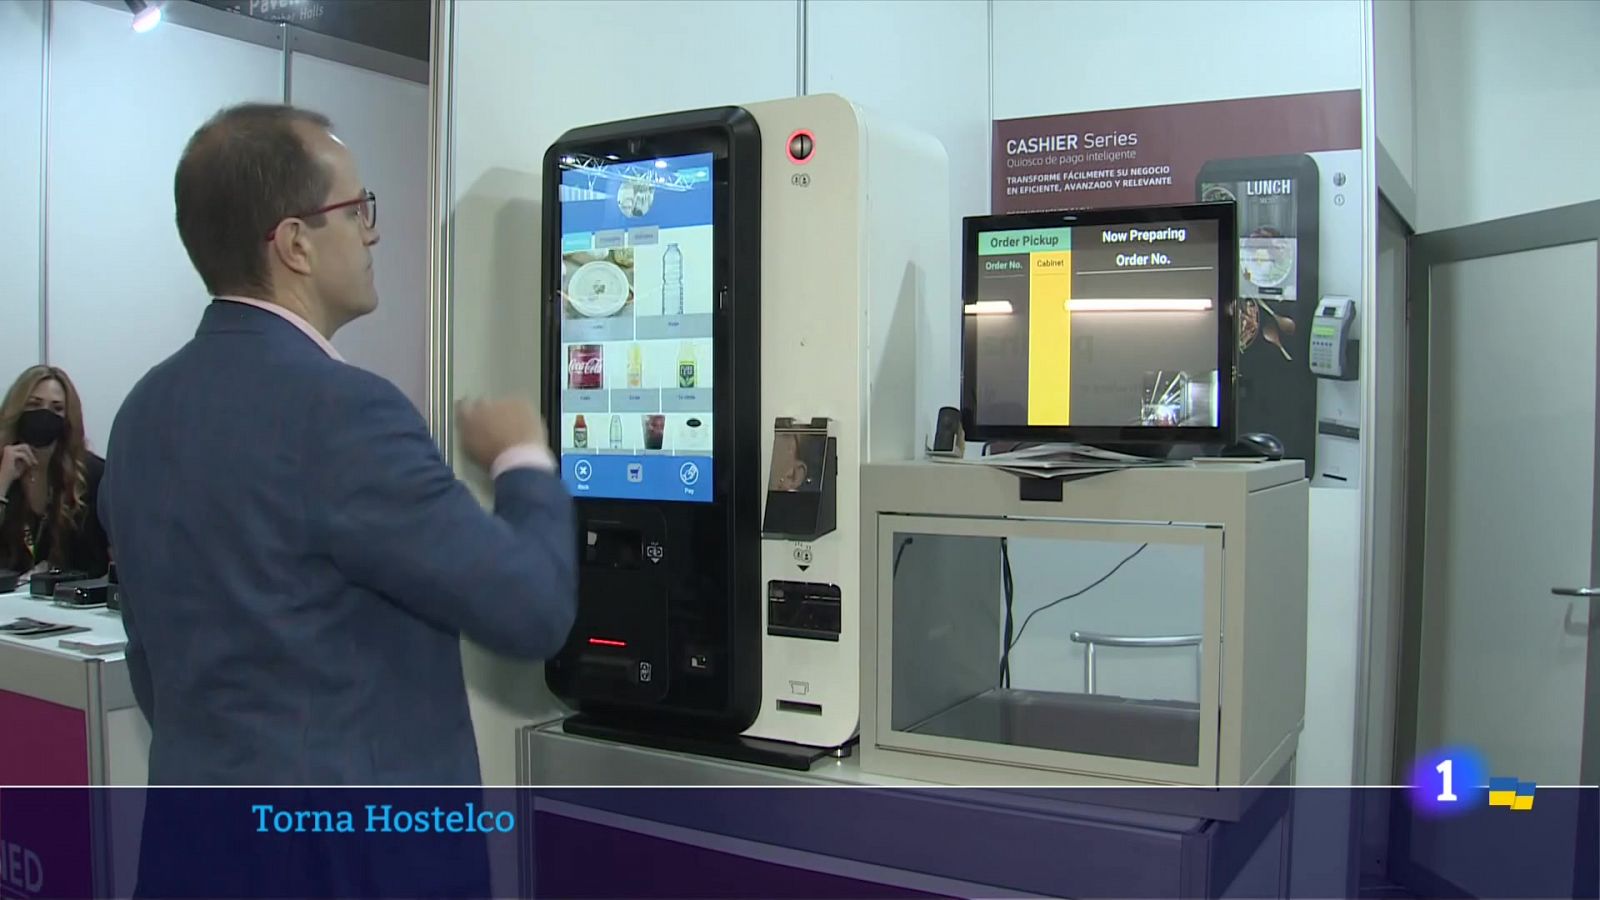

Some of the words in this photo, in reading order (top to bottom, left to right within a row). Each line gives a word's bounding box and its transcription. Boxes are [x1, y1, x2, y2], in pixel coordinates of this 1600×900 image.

[1006, 134, 1078, 155] CASHIER
[1083, 130, 1138, 149] Series
[1006, 155, 1043, 168] Quiosco
[1045, 154, 1058, 165] de
[1059, 153, 1084, 166] pago
[1086, 149, 1137, 162] inteligente
[1006, 173, 1061, 185] TRANSFORME
[1063, 168, 1115, 181] FÁCILMENTE
[1116, 168, 1129, 177] SU
[1130, 165, 1170, 176] NEGOCIO
[1006, 187, 1018, 196] EN
[1019, 183, 1063, 194] EFICIENTE,
[1064, 180, 1113, 192] AVANZADO
[1114, 179, 1121, 188] Y
[1122, 175, 1173, 188] RELEVANTE
[1246, 178, 1292, 197] LUNCH
[990, 236, 1020, 249] Order
[1022, 233, 1060, 248] Pickup
[1102, 231, 1128, 244] Now
[1129, 227, 1186, 244] Preparing
[985, 261, 1007, 271] Order
[1008, 260, 1024, 270] No.
[1036, 258, 1065, 268] Cabinet
[1115, 254, 1150, 267] Order
[1150, 252, 1172, 266] No.
